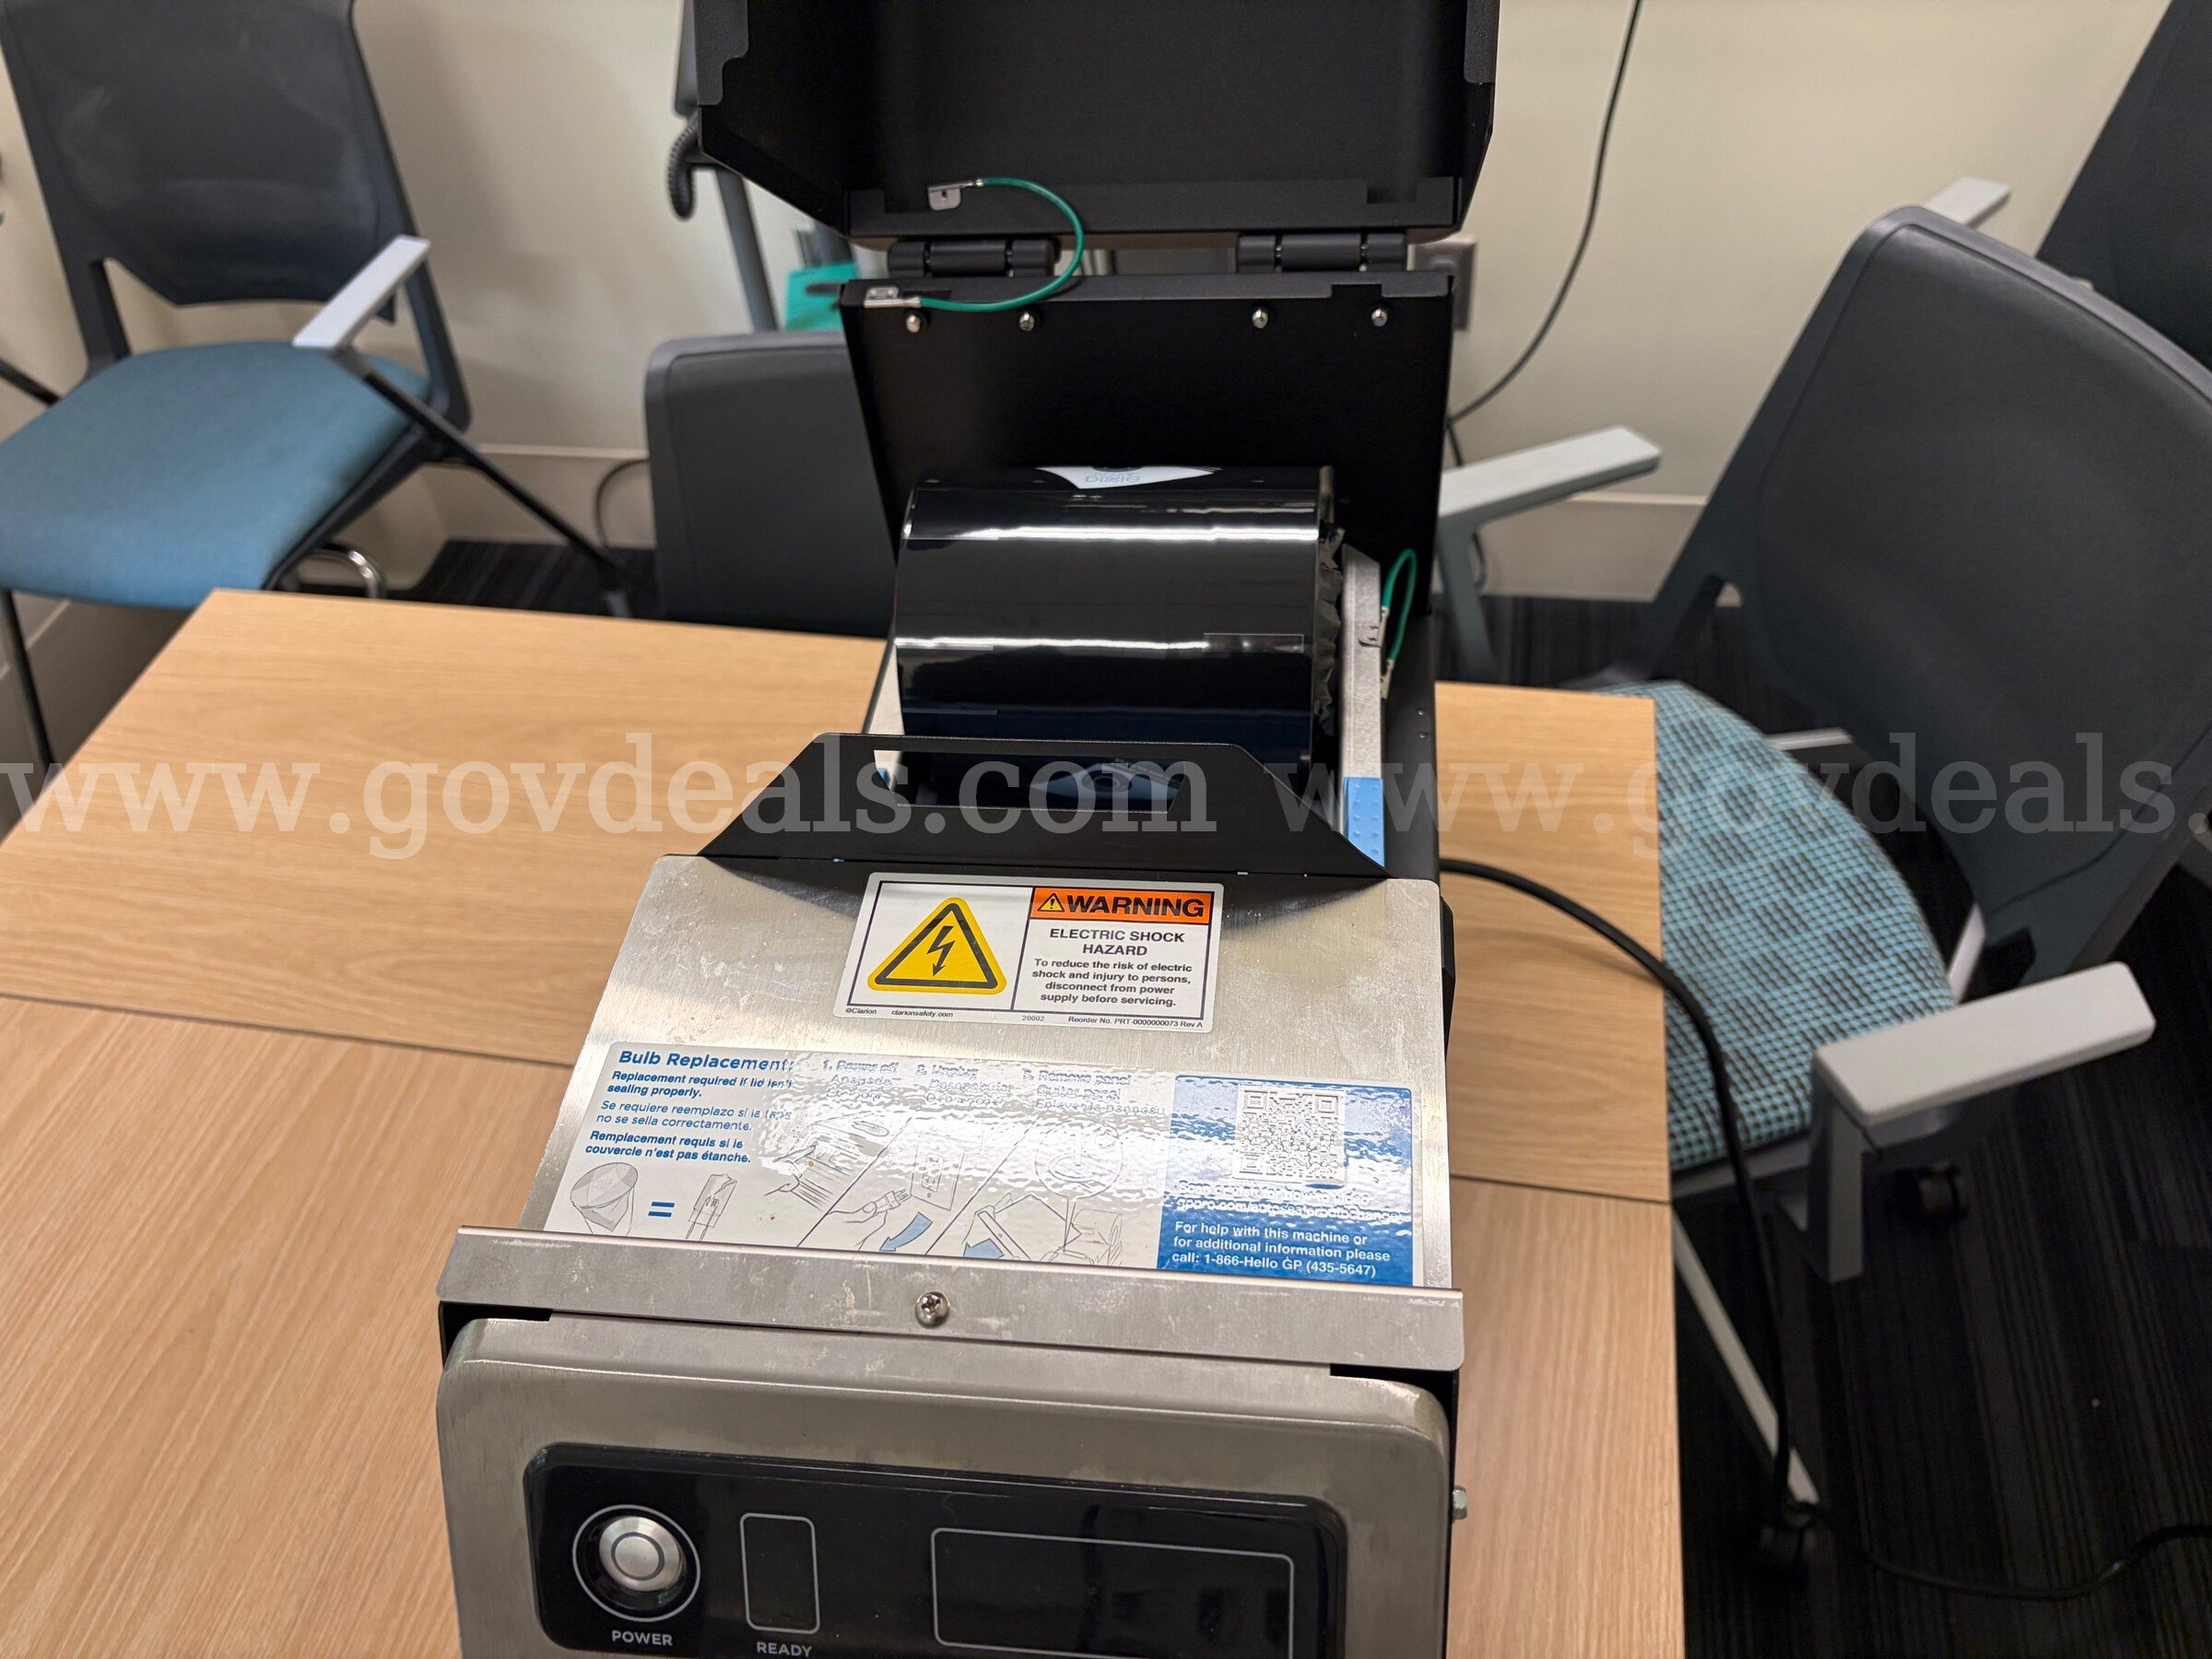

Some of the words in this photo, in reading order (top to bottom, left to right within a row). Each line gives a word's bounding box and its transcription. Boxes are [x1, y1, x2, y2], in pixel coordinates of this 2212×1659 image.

[1066, 895, 1205, 917] WARNING
[1050, 928, 1125, 940] ELECTRIC
[1129, 931, 1185, 943] SHOCK
[1082, 944, 1147, 956] HAZARD
[1034, 958, 1048, 967] To
[1052, 959, 1089, 969] reduce
[1092, 960, 1110, 970] the
[1112, 961, 1134, 970] risk
[1136, 962, 1148, 971] of
[1151, 963, 1193, 972] electric
[1032, 970, 1065, 979] shock
[1068, 971, 1089, 980] and
[1092, 971, 1124, 983] injury
[1127, 973, 1139, 982] to
[1142, 974, 1192, 985] persons,
[1045, 982, 1107, 992] disconnect
[1110, 983, 1136, 993] from
[1139, 985, 1175, 995] power
[1041, 993, 1078, 1004] supply
[1081, 994, 1118, 1005] before
[1121, 996, 1177, 1007] servicing.
[891, 1009, 954, 1018] clarionsafety.com
[1068, 1016, 1098, 1024] Reorder
[618, 1050, 662, 1065] Bulb
[612, 1070, 687, 1084] Replacement
[688, 1075, 737, 1088] required
[739, 1077, 748, 1087] if
[750, 1077, 764, 1088] lid
[606, 1083, 648, 1096] sealing
[651, 1086, 703, 1100] properly.
[601, 1100, 617, 1111] Se
[618, 1101, 669, 1114] requiere
[671, 1104, 735, 1118] reemplazo
[737, 1107, 748, 1118] si
[750, 1108, 761, 1119] la
[596, 1114, 612, 1124] no
[615, 1115, 629, 1124] se
[631, 1115, 658, 1126] sella
[662, 1117, 752, 1132] correctamente.
[589, 1130, 677, 1147] Remplacement
[678, 1135, 716, 1149] requis
[719, 1136, 731, 1148] si
[733, 1138, 744, 1149] le
[585, 1144, 641, 1157] couvercle
[644, 1146, 675, 1159] n'est
[676, 1149, 700, 1161] pas
[700, 1148, 752, 1163] étanche.
[1175, 1221, 1197, 1233] For
[1200, 1222, 1230, 1236] help
[1233, 1225, 1260, 1237] with
[1264, 1227, 1289, 1239] this
[1292, 1230, 1349, 1243] machine
[1353, 1235, 1368, 1244] or
[1173, 1236, 1192, 1247] for
[1195, 1237, 1262, 1253] additional
[1265, 1242, 1346, 1258] information
[1346, 1248, 1391, 1262] please
[1171, 1252, 1200, 1264] call:
[1204, 1253, 1278, 1270] 1-866-Hello
[1281, 1258, 1302, 1271] GP
[1306, 1260, 1377, 1278] (435-5647)
[611, 1630, 674, 1647] POWER
[756, 1641, 813, 1658] READY
